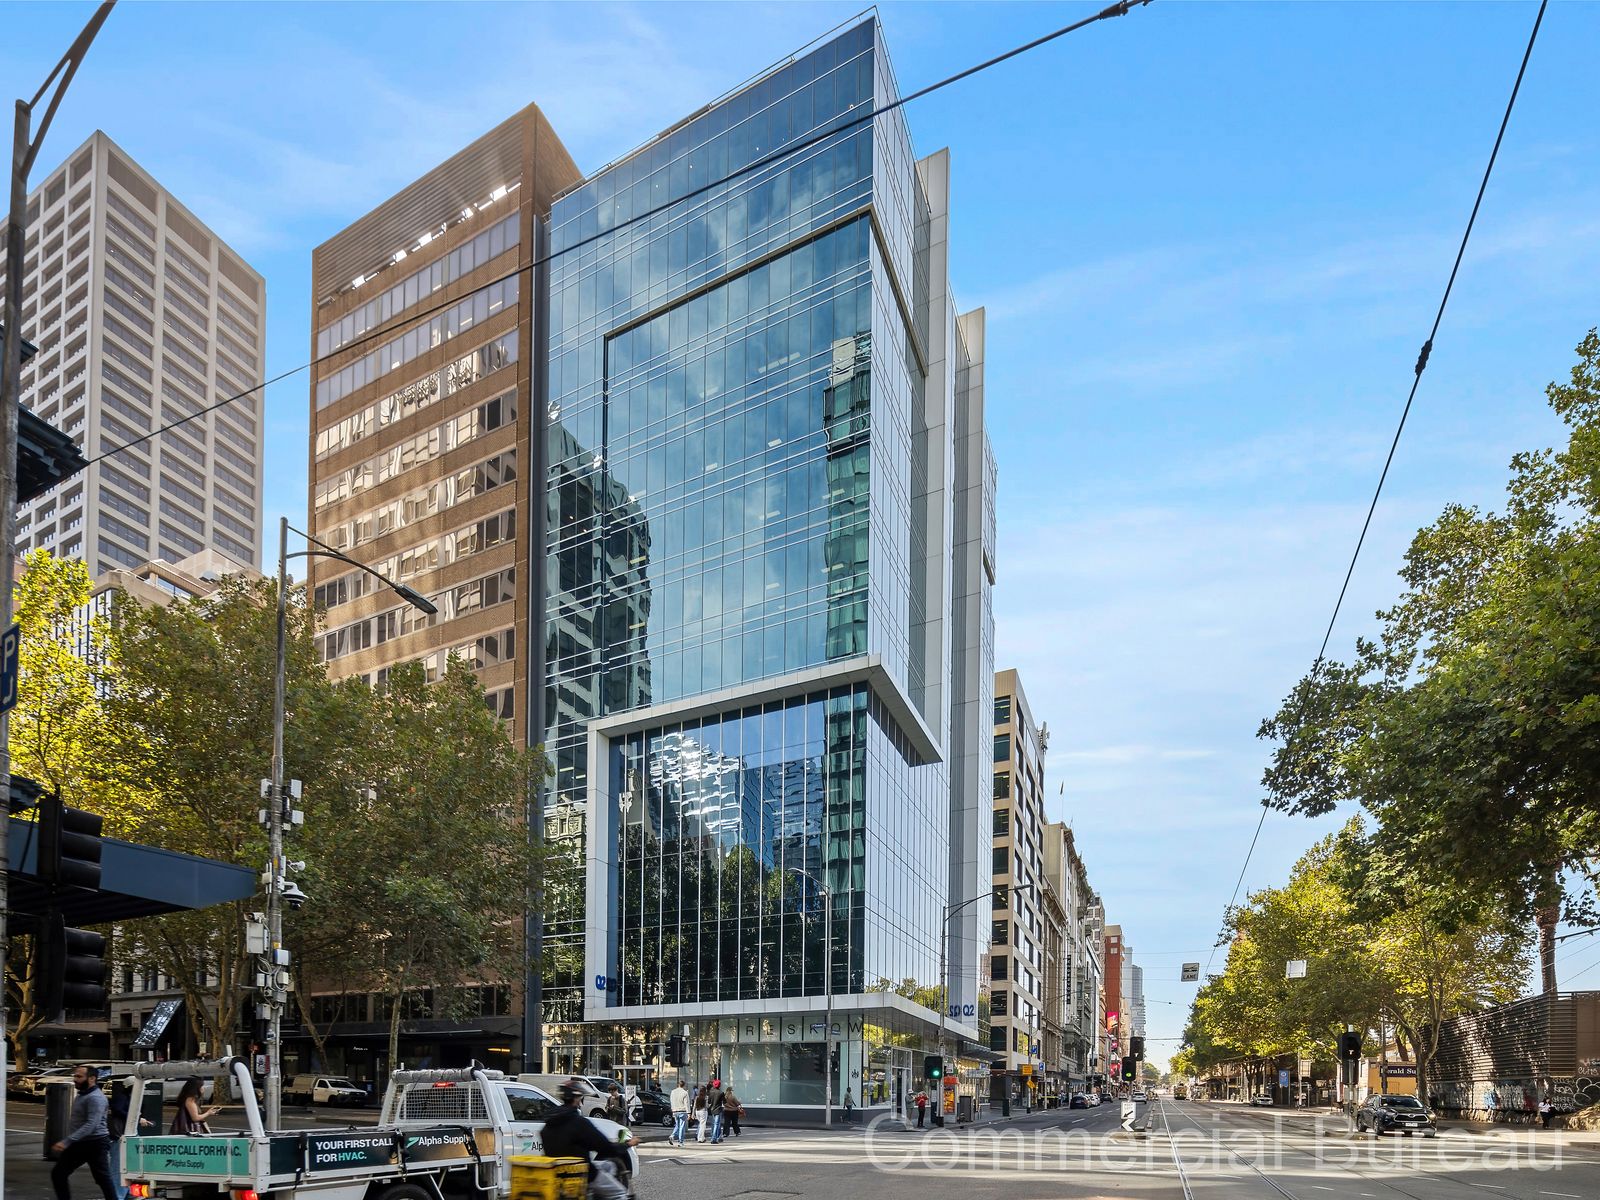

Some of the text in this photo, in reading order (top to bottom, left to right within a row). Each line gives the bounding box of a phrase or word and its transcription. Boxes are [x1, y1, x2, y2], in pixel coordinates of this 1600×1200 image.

[4, 634, 15, 673] P
[963, 1004, 975, 1016] Q2
[316, 1138, 394, 1150] YOUR FIRST CALL
[418, 1134, 469, 1147] Alpha Supply
[156, 1145, 177, 1155] FIRST
[178, 1145, 197, 1155] CALL
[200, 1146, 216, 1156] FOR
[217, 1146, 242, 1156] HVC.
[316, 1151, 367, 1163] FOR HVAC.
[187, 1160, 205, 1169] Supply
